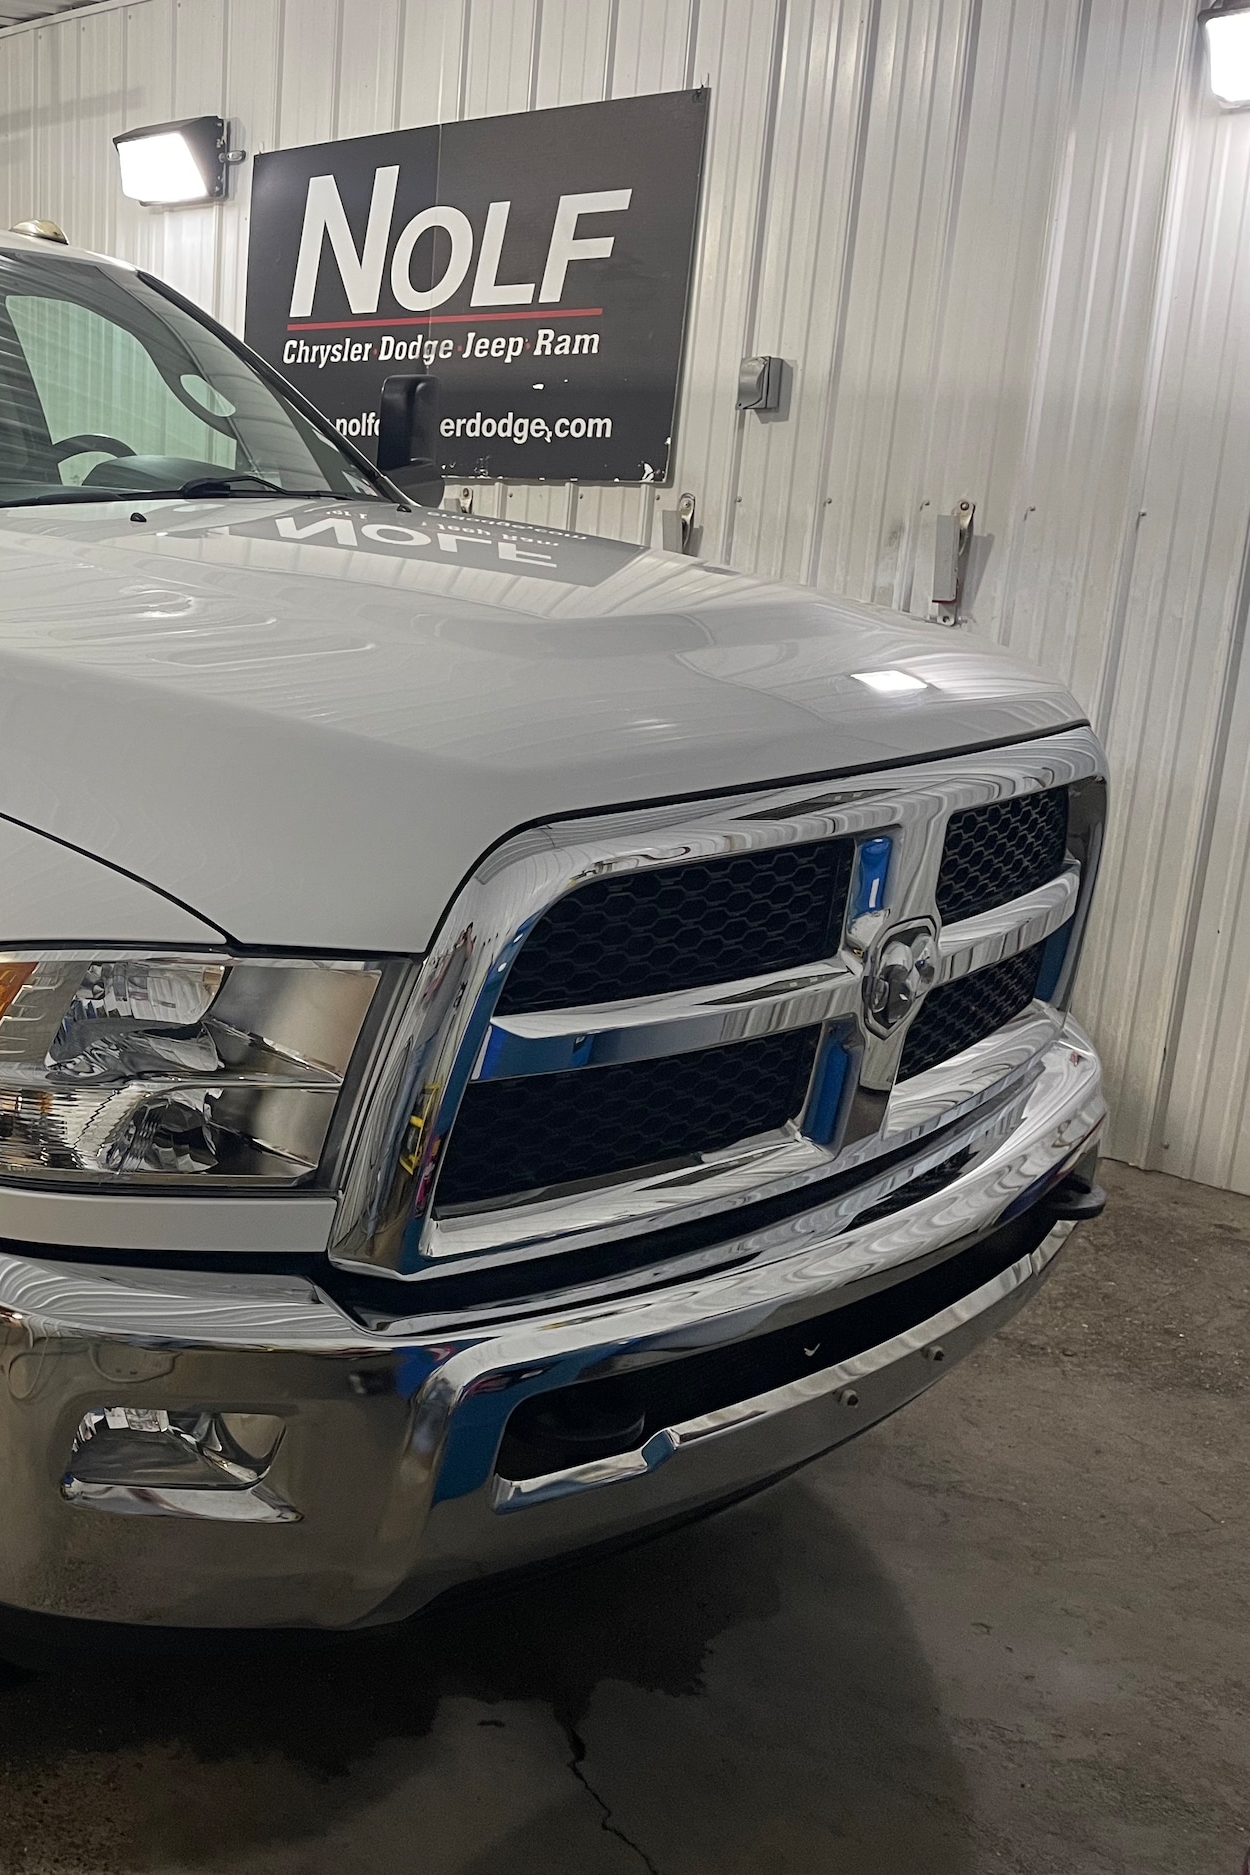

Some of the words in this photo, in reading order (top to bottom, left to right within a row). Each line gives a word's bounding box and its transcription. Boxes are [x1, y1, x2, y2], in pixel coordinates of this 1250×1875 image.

[289, 164, 632, 318] NOLF
[283, 338, 373, 369] Chrysler
[378, 334, 452, 366] Dodge
[461, 332, 523, 363] Jeep
[533, 328, 600, 356] Ram
